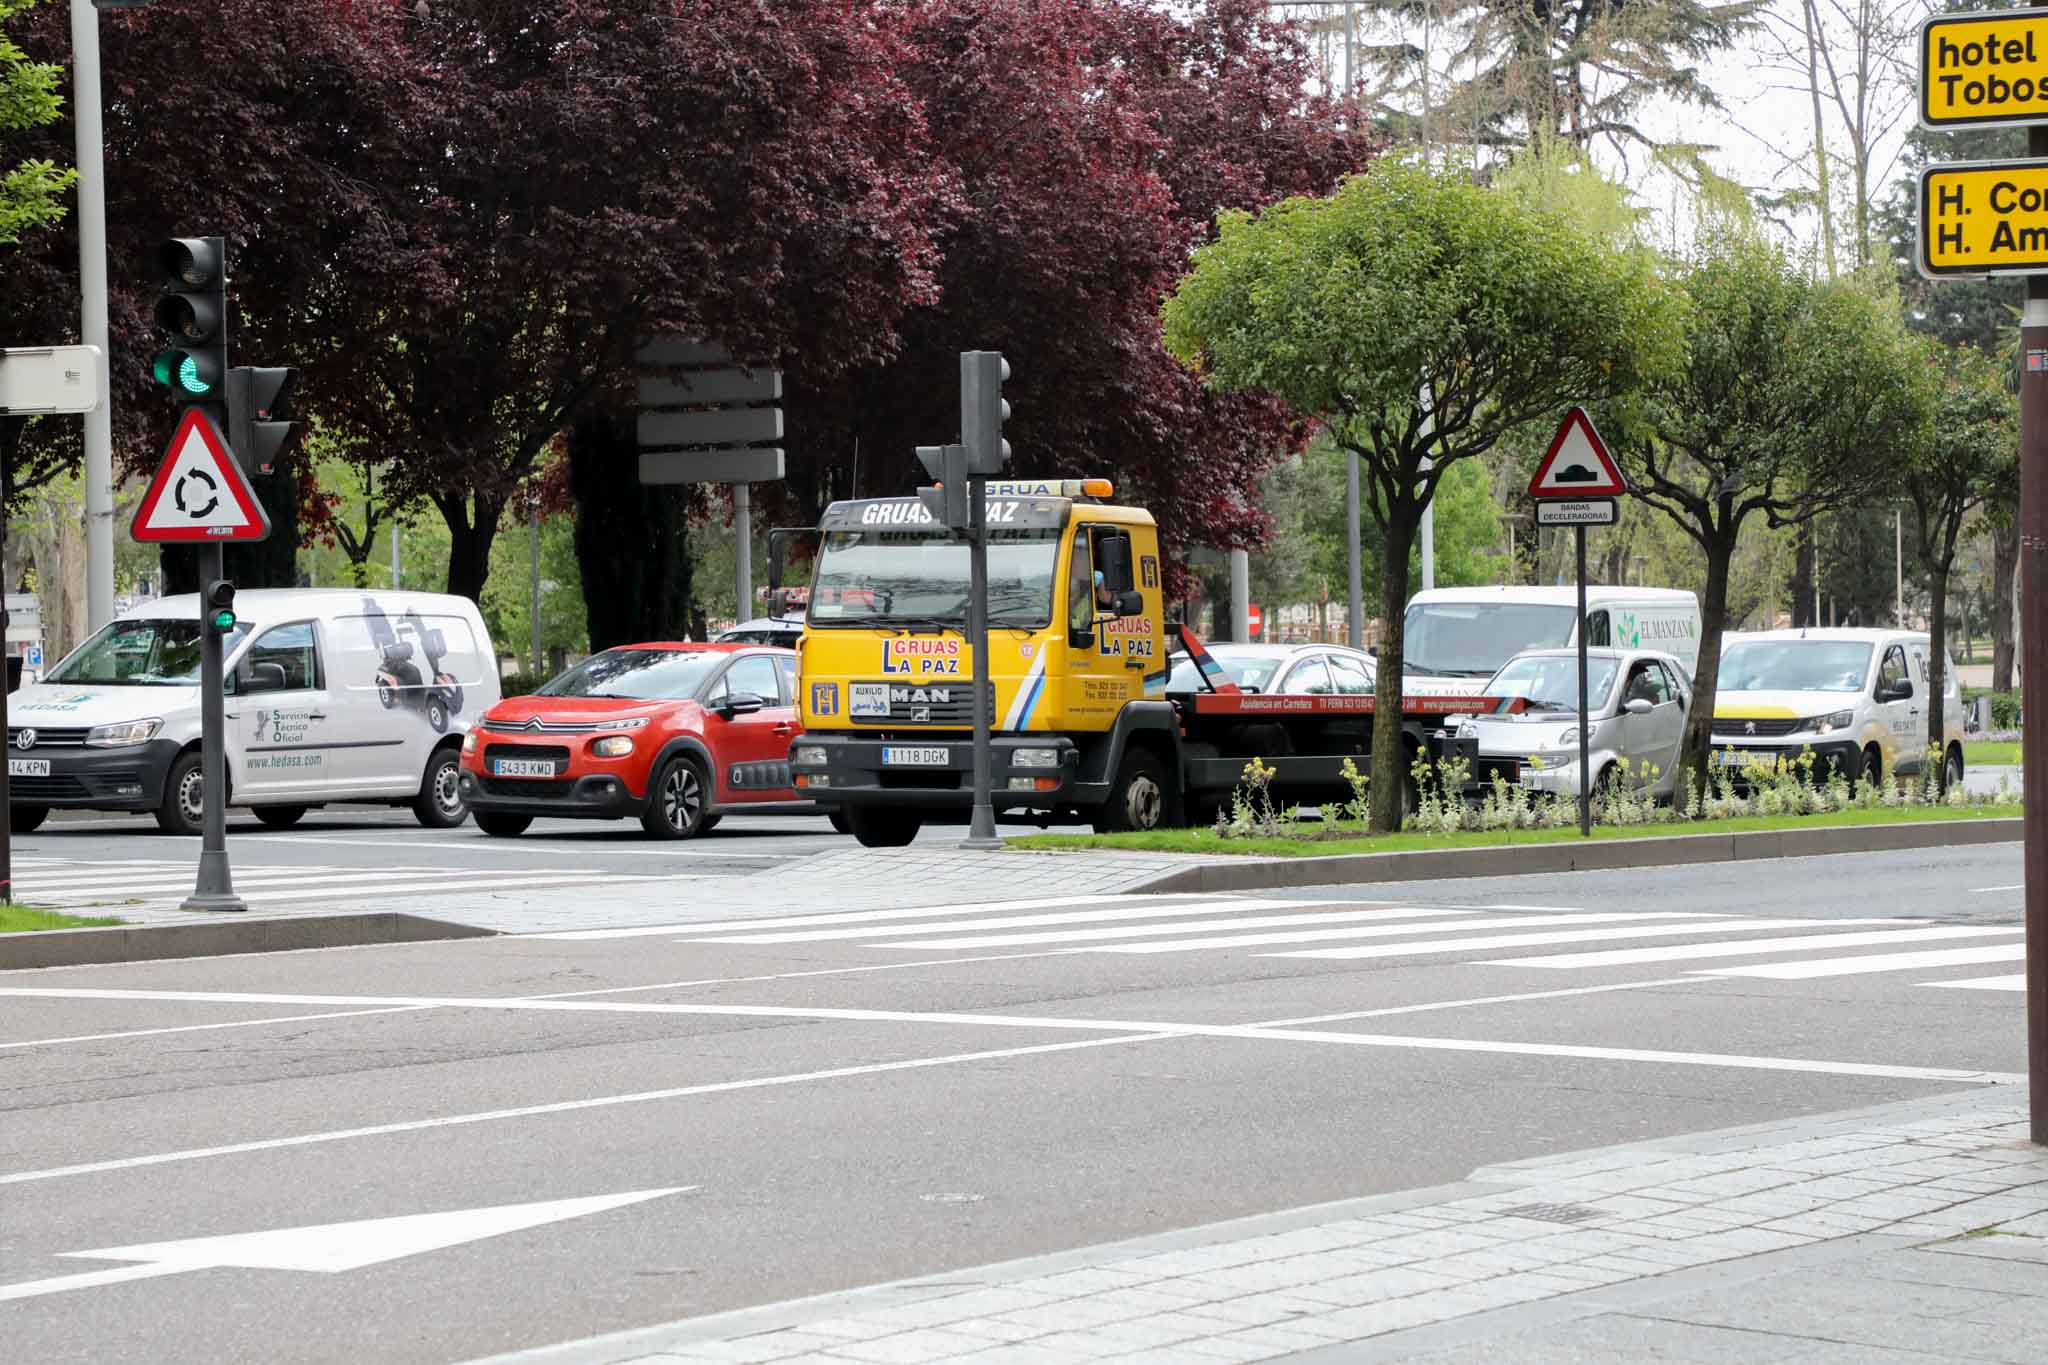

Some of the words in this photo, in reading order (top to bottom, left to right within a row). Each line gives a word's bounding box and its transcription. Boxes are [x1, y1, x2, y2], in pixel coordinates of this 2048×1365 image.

[1938, 30, 2037, 68] hotel
[1938, 184, 1971, 217] H.
[1938, 222, 1971, 255] H.
[1560, 503, 1591, 511] BANDAS
[1107, 616, 1152, 634] GRUAS
[1100, 616, 1121, 655] LA
[1128, 640, 1152, 656] PAZ
[895, 640, 958, 654] GRUAS
[883, 640, 911, 673] LA
[922, 659, 958, 673] PAZ
[855, 687, 882, 696] AUXILIO
[890, 688, 950, 703] MAN
[247, 754, 322, 769] www.hedasa.com
[893, 750, 920, 762] 1118
[923, 750, 946, 762] DGK
[26, 761, 47, 774] KPN
